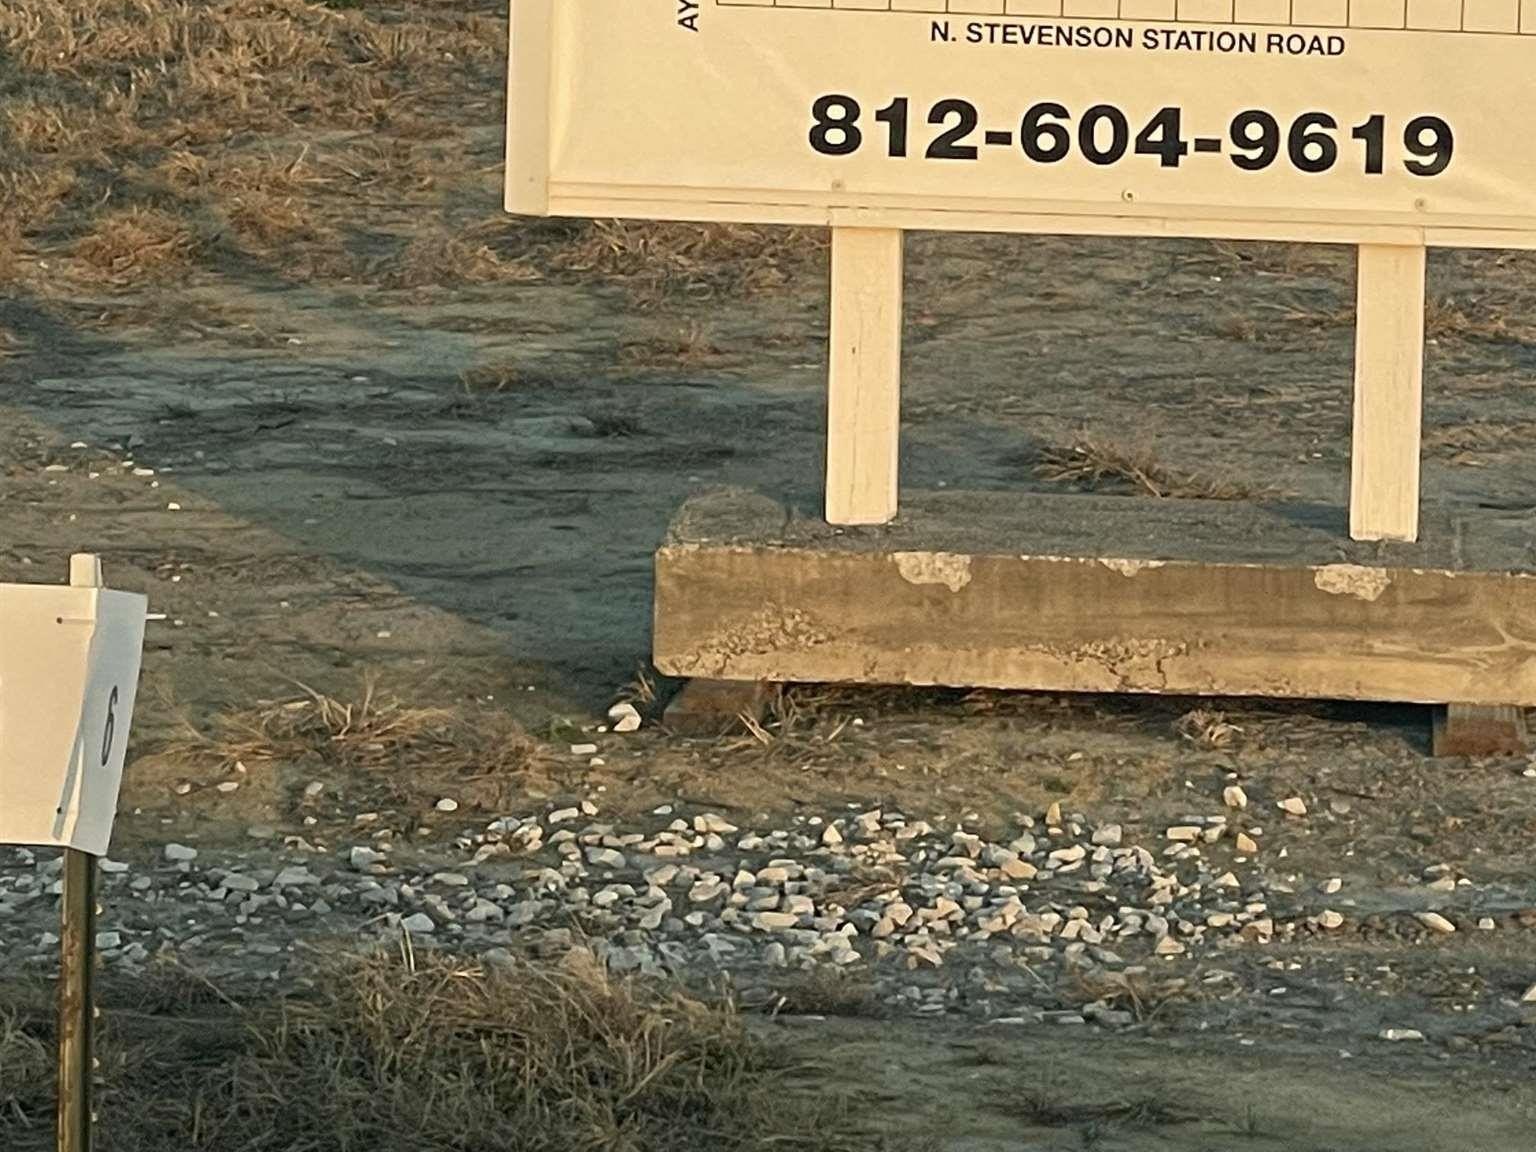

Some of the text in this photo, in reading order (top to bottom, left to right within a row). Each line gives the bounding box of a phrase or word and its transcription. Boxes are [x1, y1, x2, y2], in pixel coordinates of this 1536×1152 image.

[932, 22, 1345, 56] N. STEVENSON STATION ROAD
[809, 95, 1453, 176] 812-604-9619
